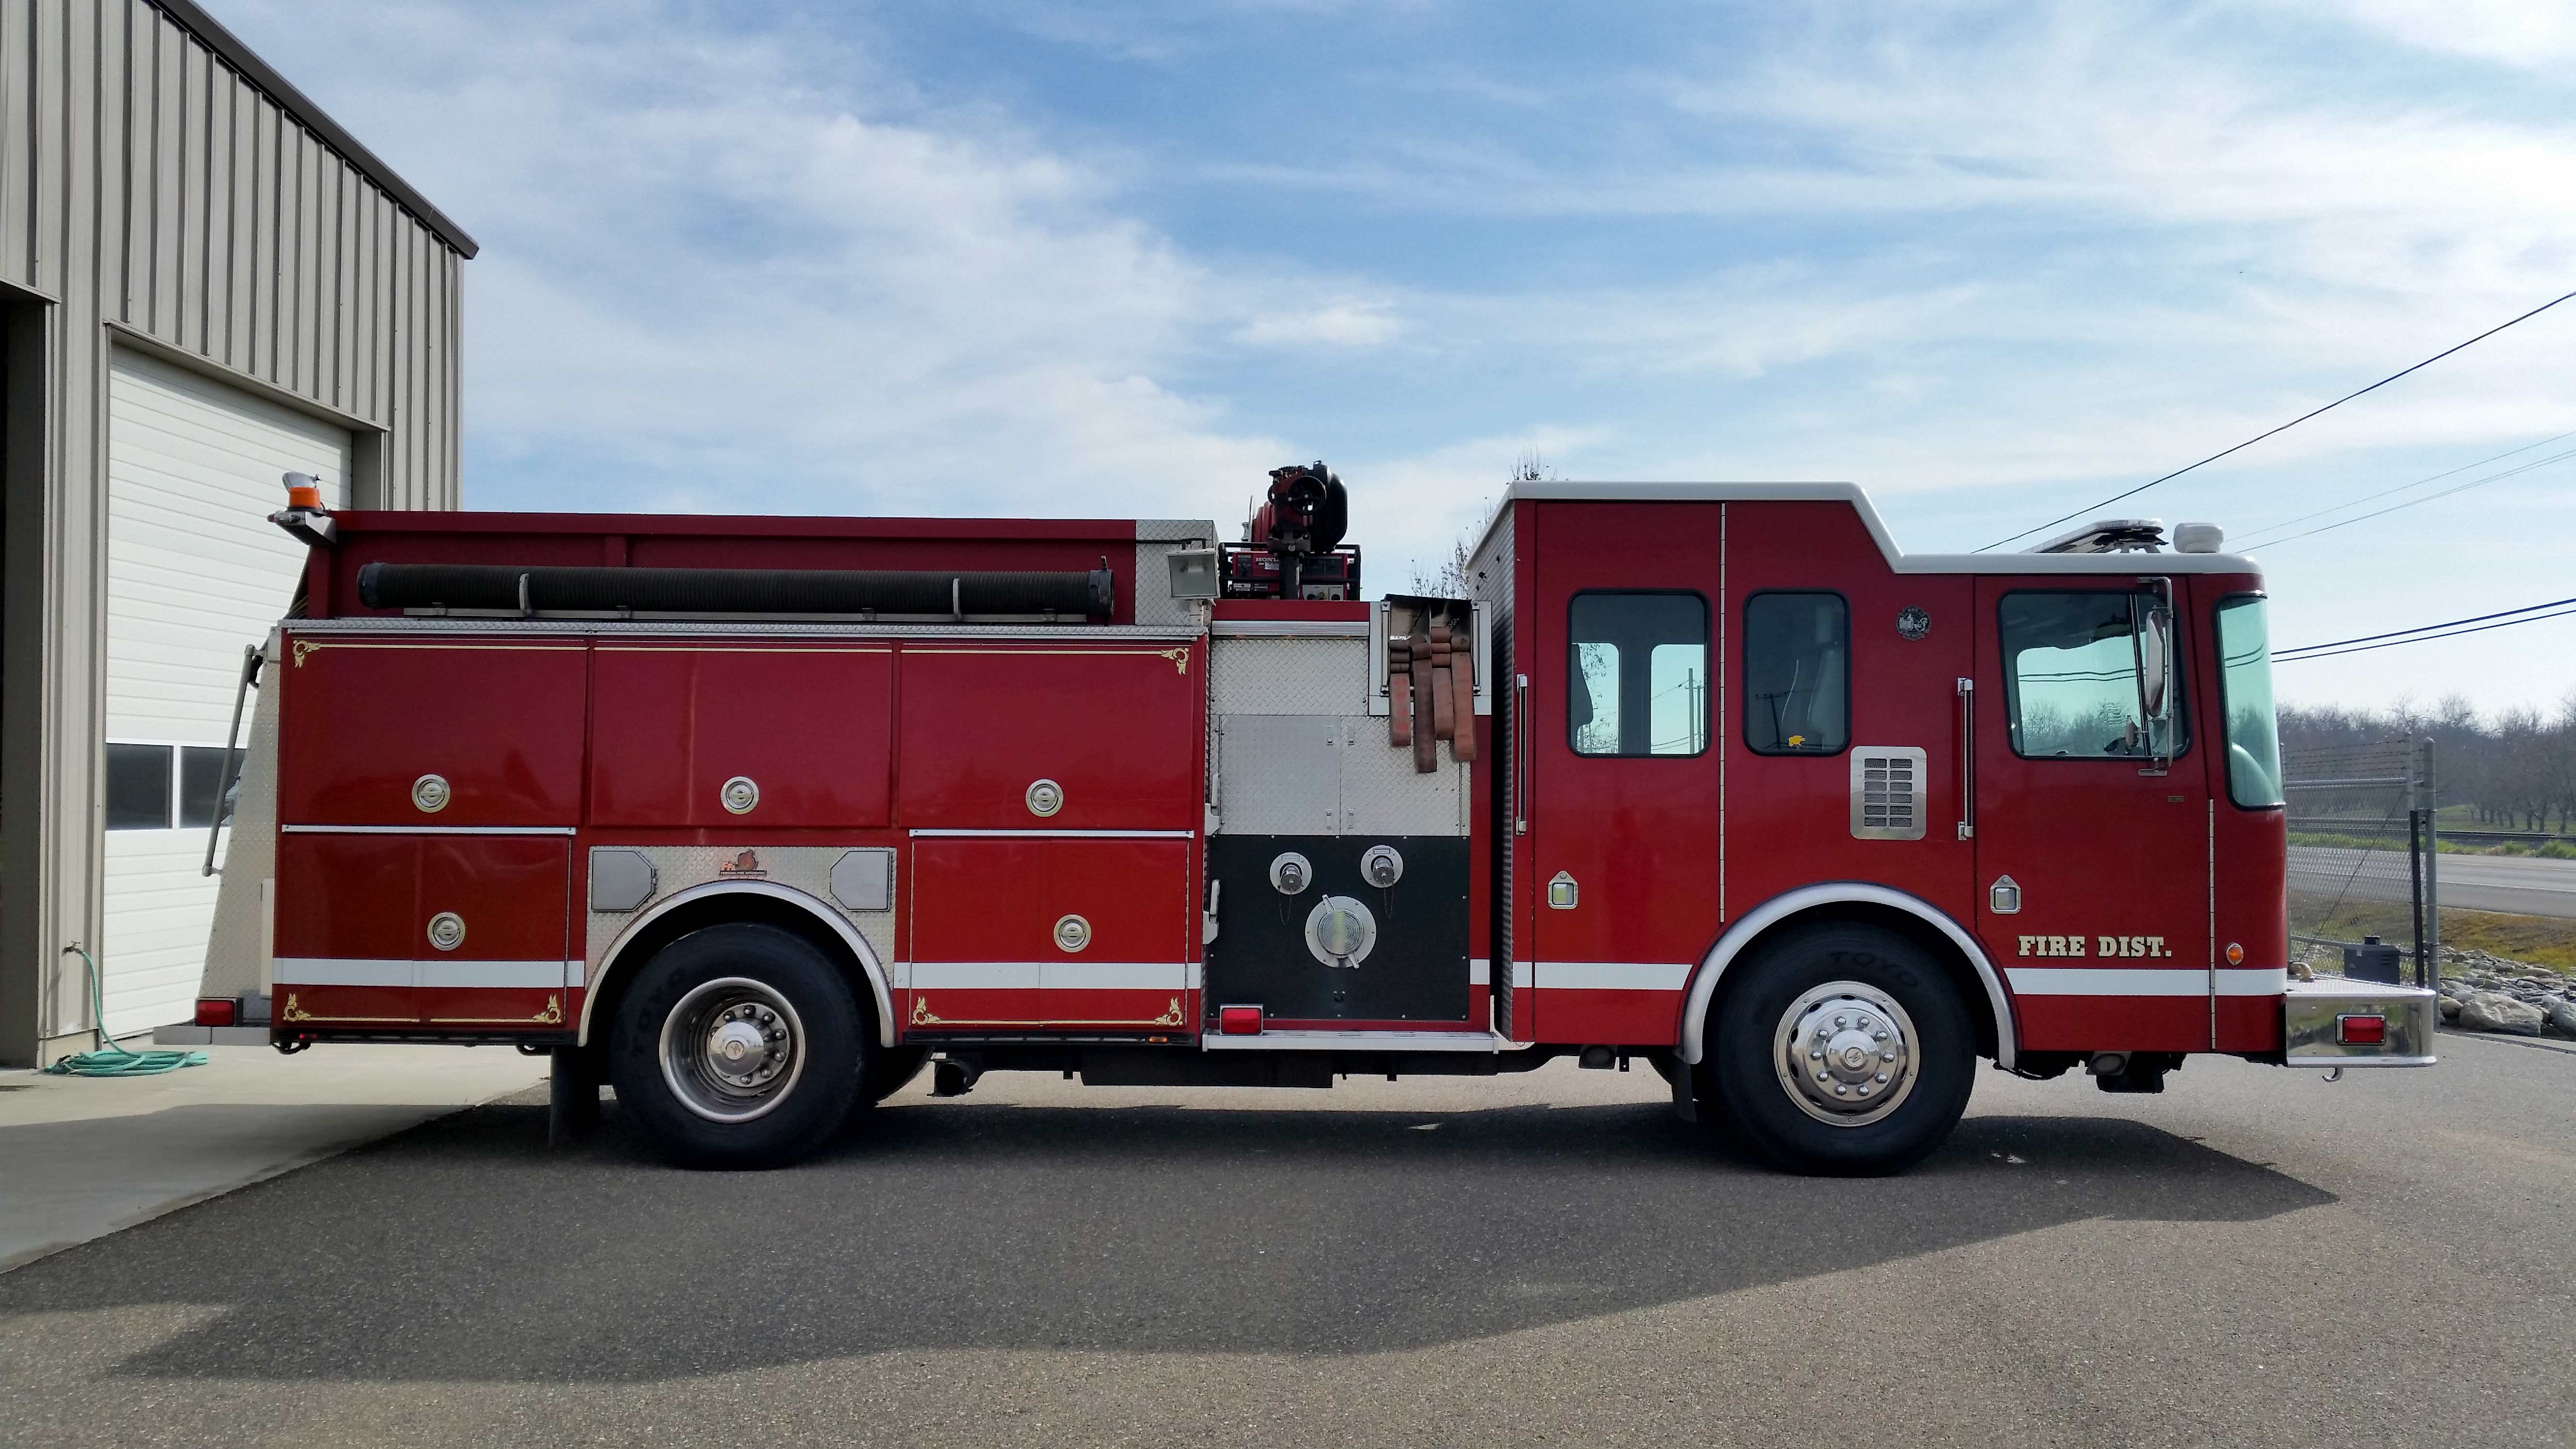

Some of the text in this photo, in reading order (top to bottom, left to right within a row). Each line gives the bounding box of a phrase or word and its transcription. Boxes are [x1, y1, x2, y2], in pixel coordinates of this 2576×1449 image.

[2018, 935, 2172, 957] FIRE DIST.
[1829, 951, 1918, 987] TOYO
